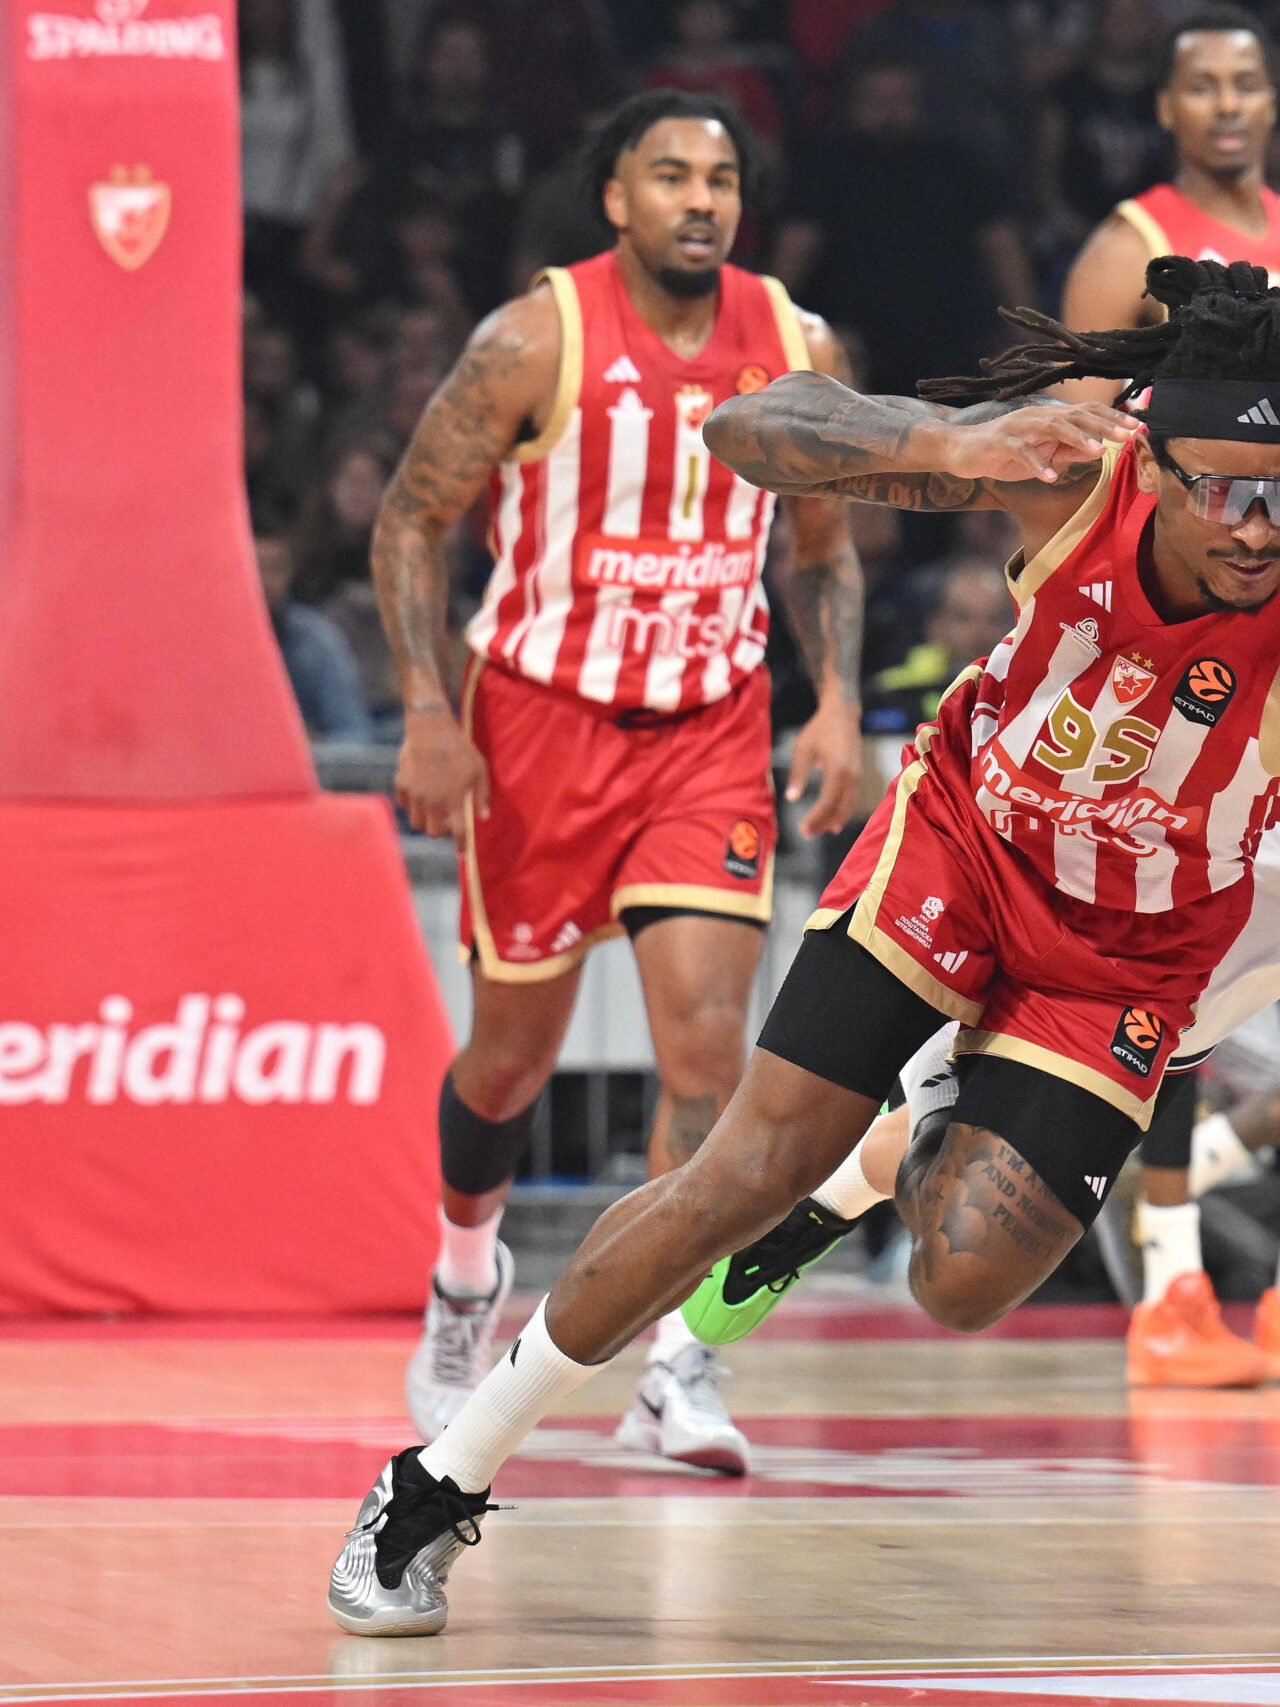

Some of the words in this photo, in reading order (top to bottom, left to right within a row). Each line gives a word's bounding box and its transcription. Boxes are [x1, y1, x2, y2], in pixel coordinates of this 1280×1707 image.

[27, 12, 224, 61] SPALDING
[588, 545, 753, 587] meridian
[609, 602, 730, 660] mts
[1174, 696, 1216, 722] ETIHAD
[1032, 687, 1161, 785] 95
[981, 746, 1188, 830] meridian
[1112, 1046, 1148, 1074] ETIHAD
